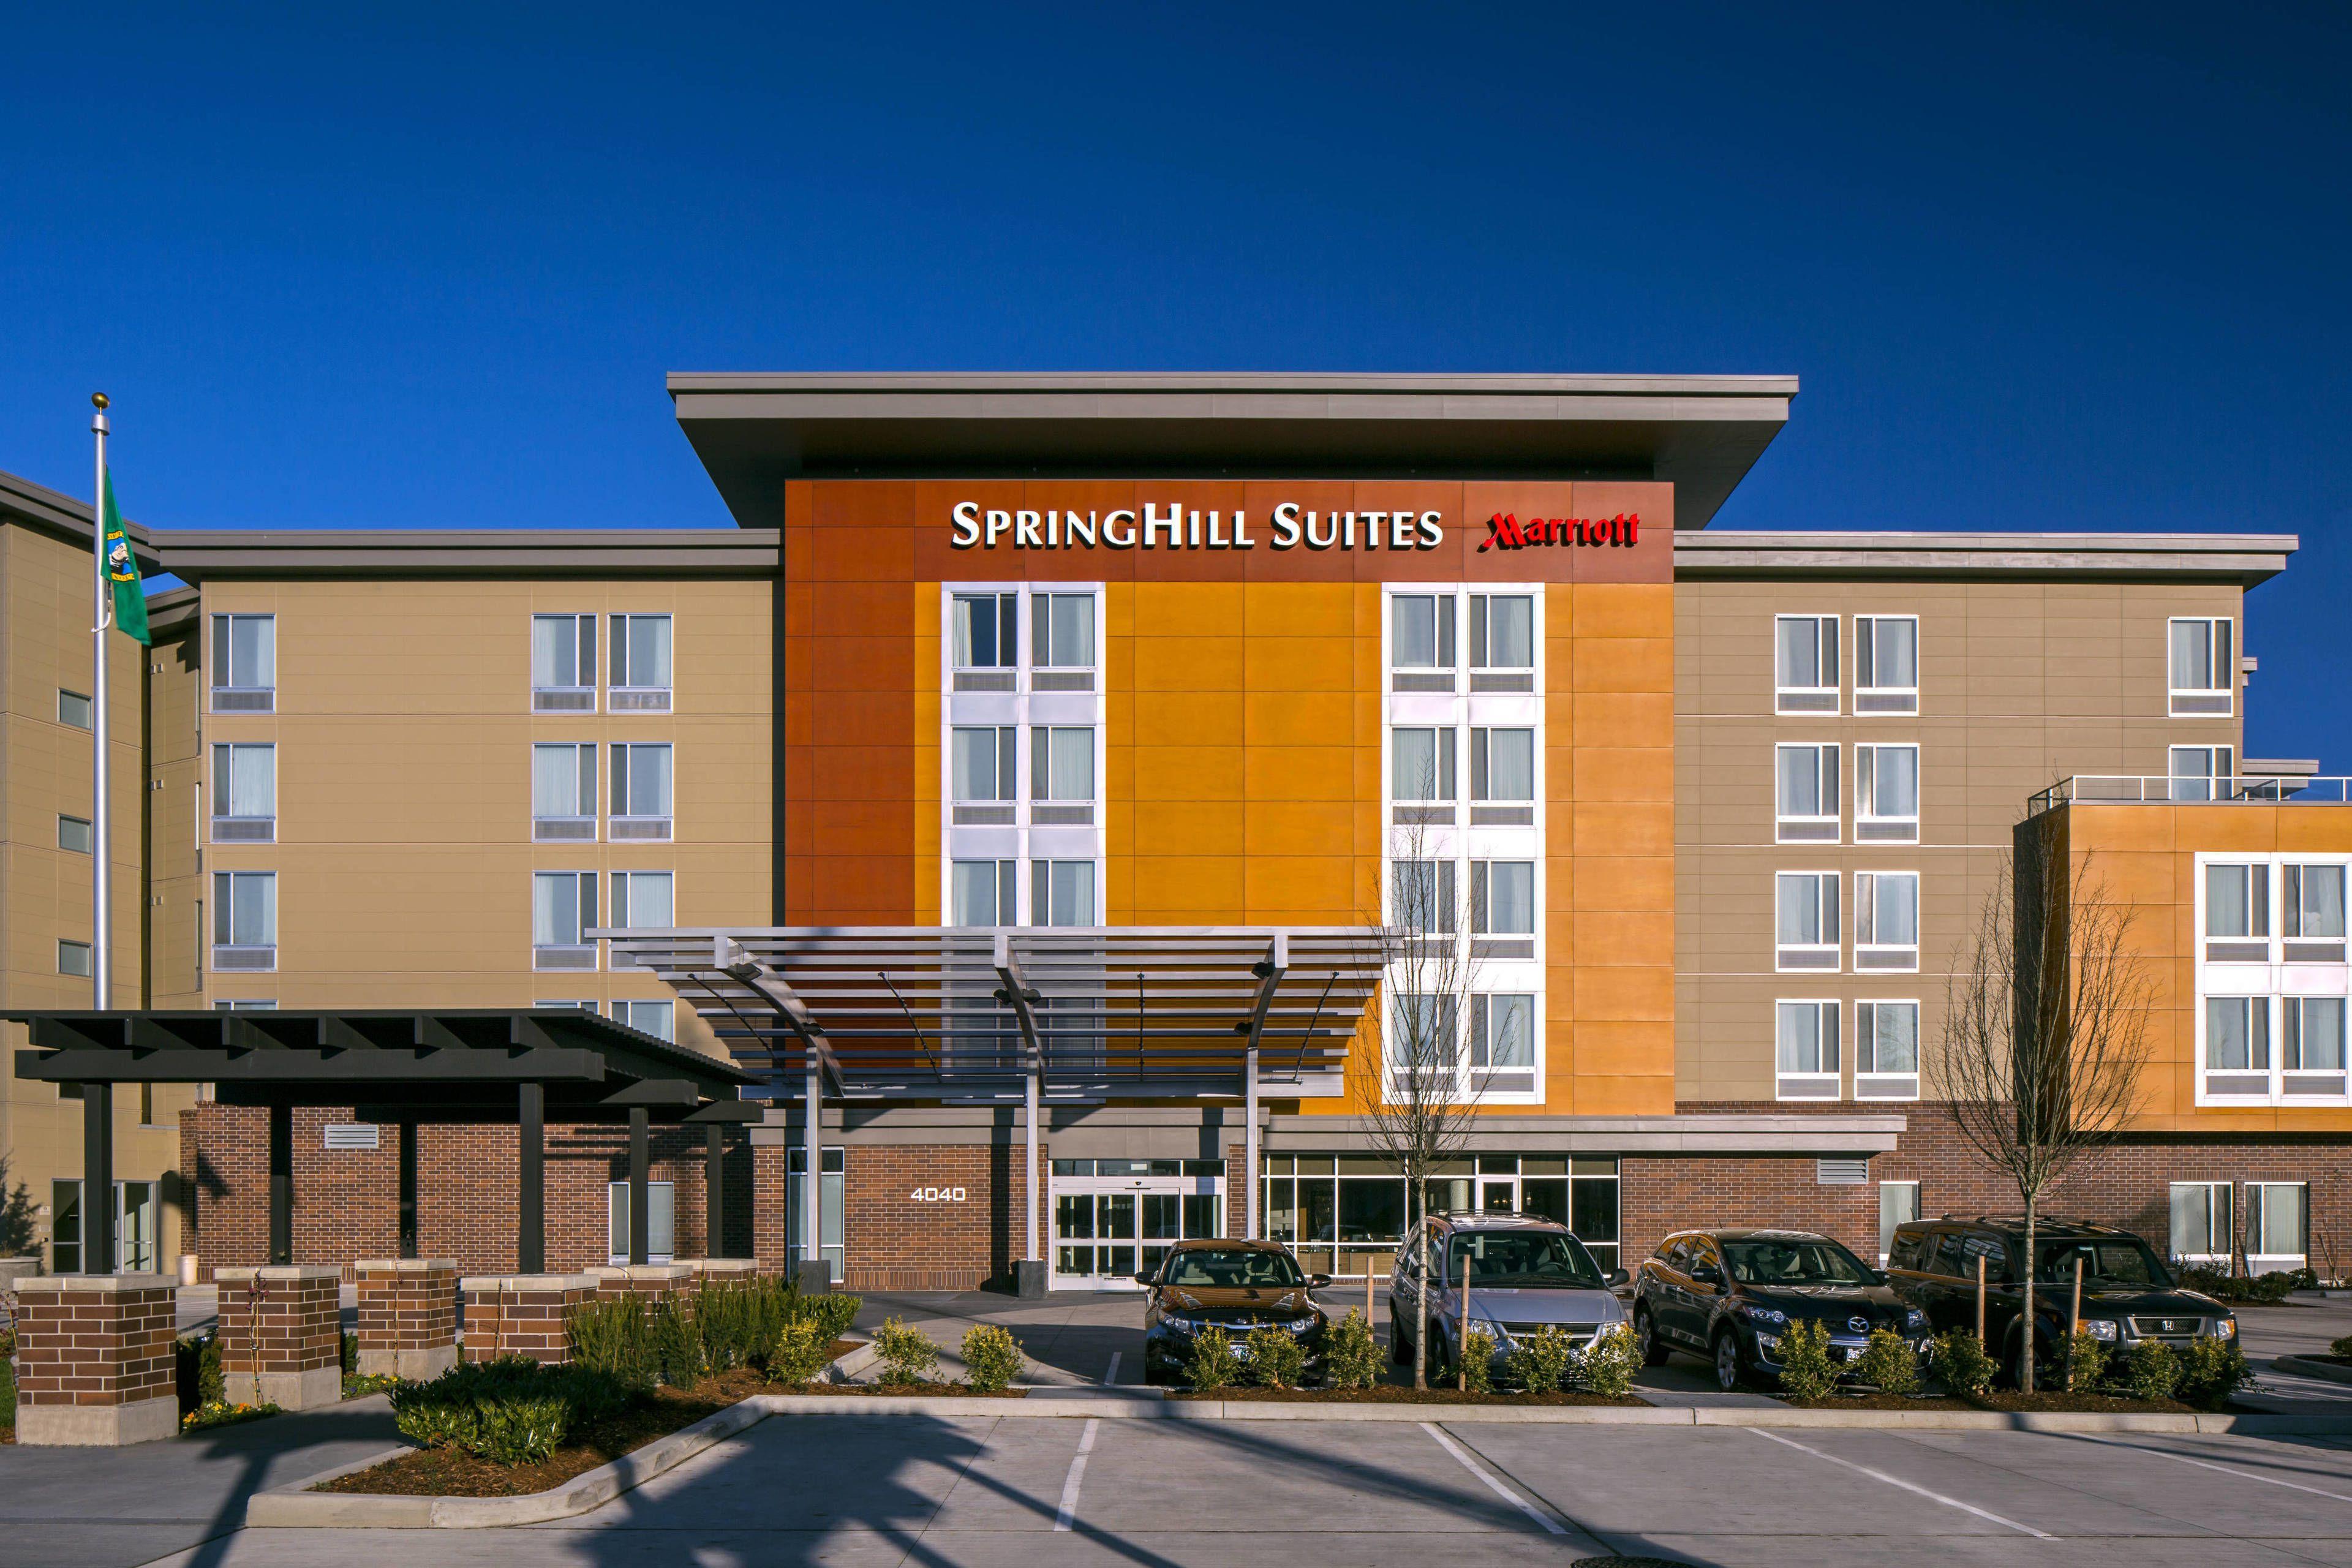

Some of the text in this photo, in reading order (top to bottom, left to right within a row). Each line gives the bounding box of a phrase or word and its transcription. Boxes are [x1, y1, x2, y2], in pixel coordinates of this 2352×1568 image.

[951, 501, 1444, 546] SPRINGHILL SUITES
[1483, 512, 1640, 546] Marriott
[910, 1187, 966, 1202] 4040
